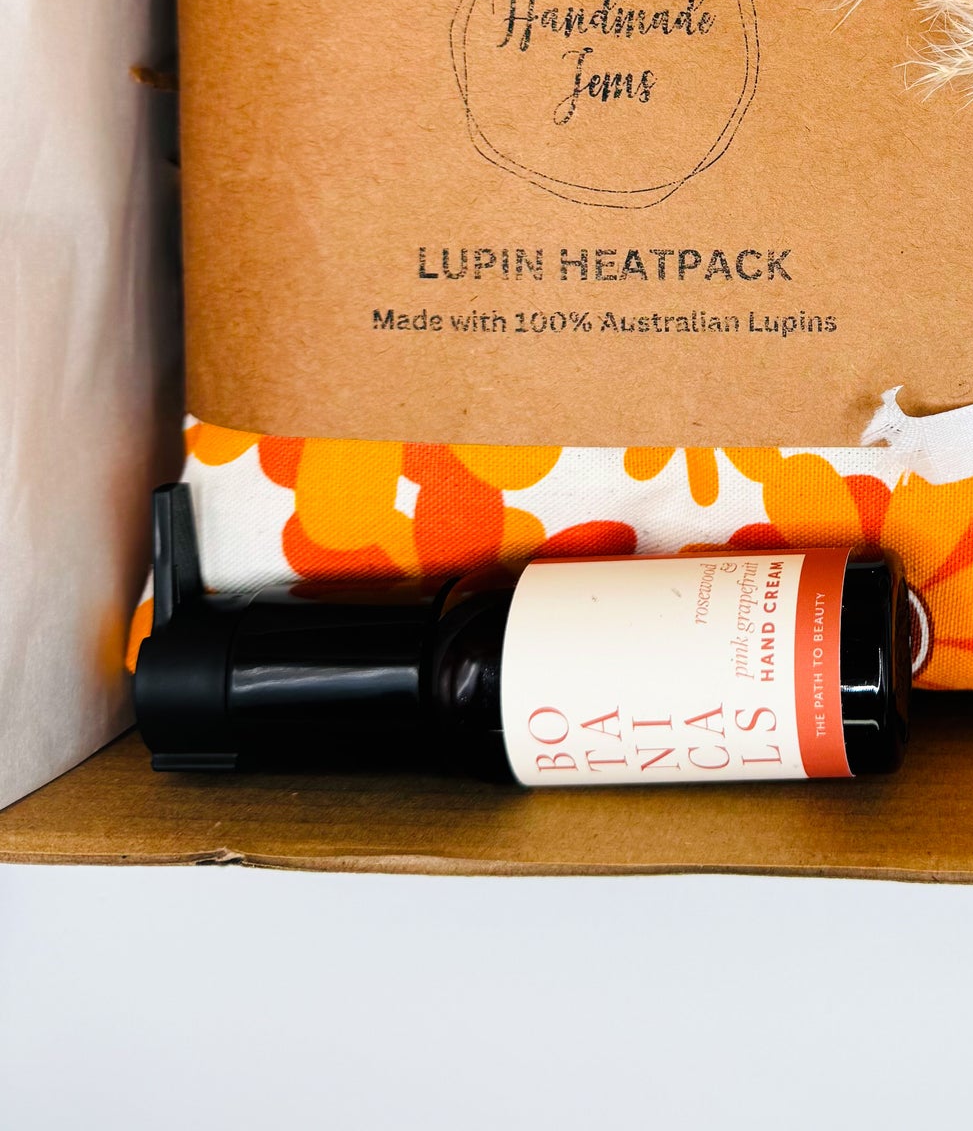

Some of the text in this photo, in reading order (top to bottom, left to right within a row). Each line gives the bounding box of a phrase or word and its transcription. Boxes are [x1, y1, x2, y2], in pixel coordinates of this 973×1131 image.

[552, 47, 657, 126] Jems
[417, 247, 792, 282] LUPIN HEATPACK
[372, 310, 838, 338] Made with 100% Australian Lupins
[695, 563, 717, 625] rosewood
[730, 562, 759, 680] pink grapefruit
[760, 561, 785, 682] HAND CREAM
[812, 592, 827, 737] THE PATH TO BEAUTY
